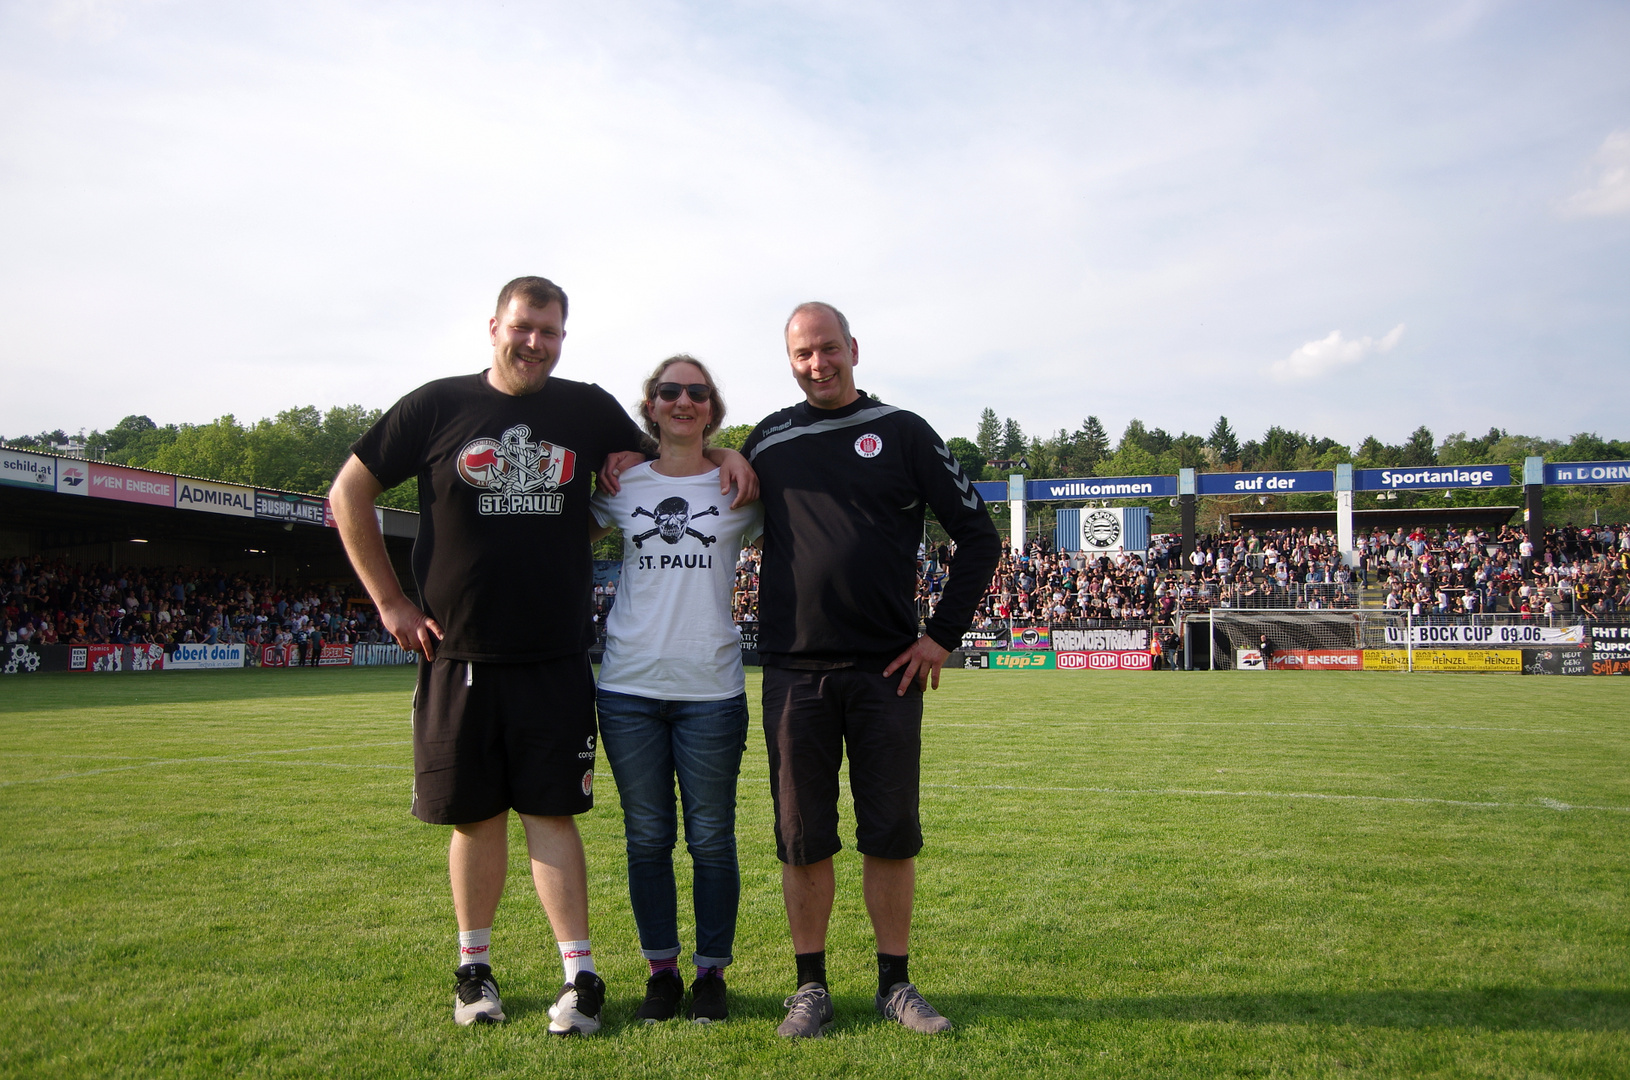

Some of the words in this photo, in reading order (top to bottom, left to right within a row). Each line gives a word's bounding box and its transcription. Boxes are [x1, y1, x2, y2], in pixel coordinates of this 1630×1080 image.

[762, 419, 792, 438] hummel
[461, 440, 502, 460] ANTIFASCHISTISC
[1381, 469, 1493, 487] Sportanlage
[1557, 469, 1572, 480] in
[93, 475, 122, 489] WIEN
[126, 479, 170, 496] ENERGIE
[1050, 483, 1152, 496] willkommen
[1234, 476, 1263, 490] auf
[1266, 476, 1295, 489] der
[179, 484, 253, 511] ADMIRAL
[481, 495, 507, 512] ST.
[261, 498, 318, 520] BUSHPLANET
[638, 555, 656, 570] ST.
[660, 554, 712, 569] PAULI
[962, 632, 997, 640] OTBALL
[1420, 626, 1459, 641] BOCK
[1463, 626, 1493, 641] CUP
[1501, 626, 1546, 642] 09.06.
[1592, 627, 1618, 638] FHT
[174, 646, 208, 661] obert
[210, 644, 240, 660] daim
[1272, 655, 1303, 665] WIEN
[1307, 655, 1359, 665] ENERGIE
[996, 654, 1047, 668] tipp3
[1061, 655, 1084, 667] DOM
[1092, 655, 1115, 667] DOM
[1123, 655, 1147, 667] DOM
[1432, 657, 1467, 665] HEINZEL
[1485, 657, 1520, 665] HEINZEL
[1592, 659, 1630, 675] SCHAN
